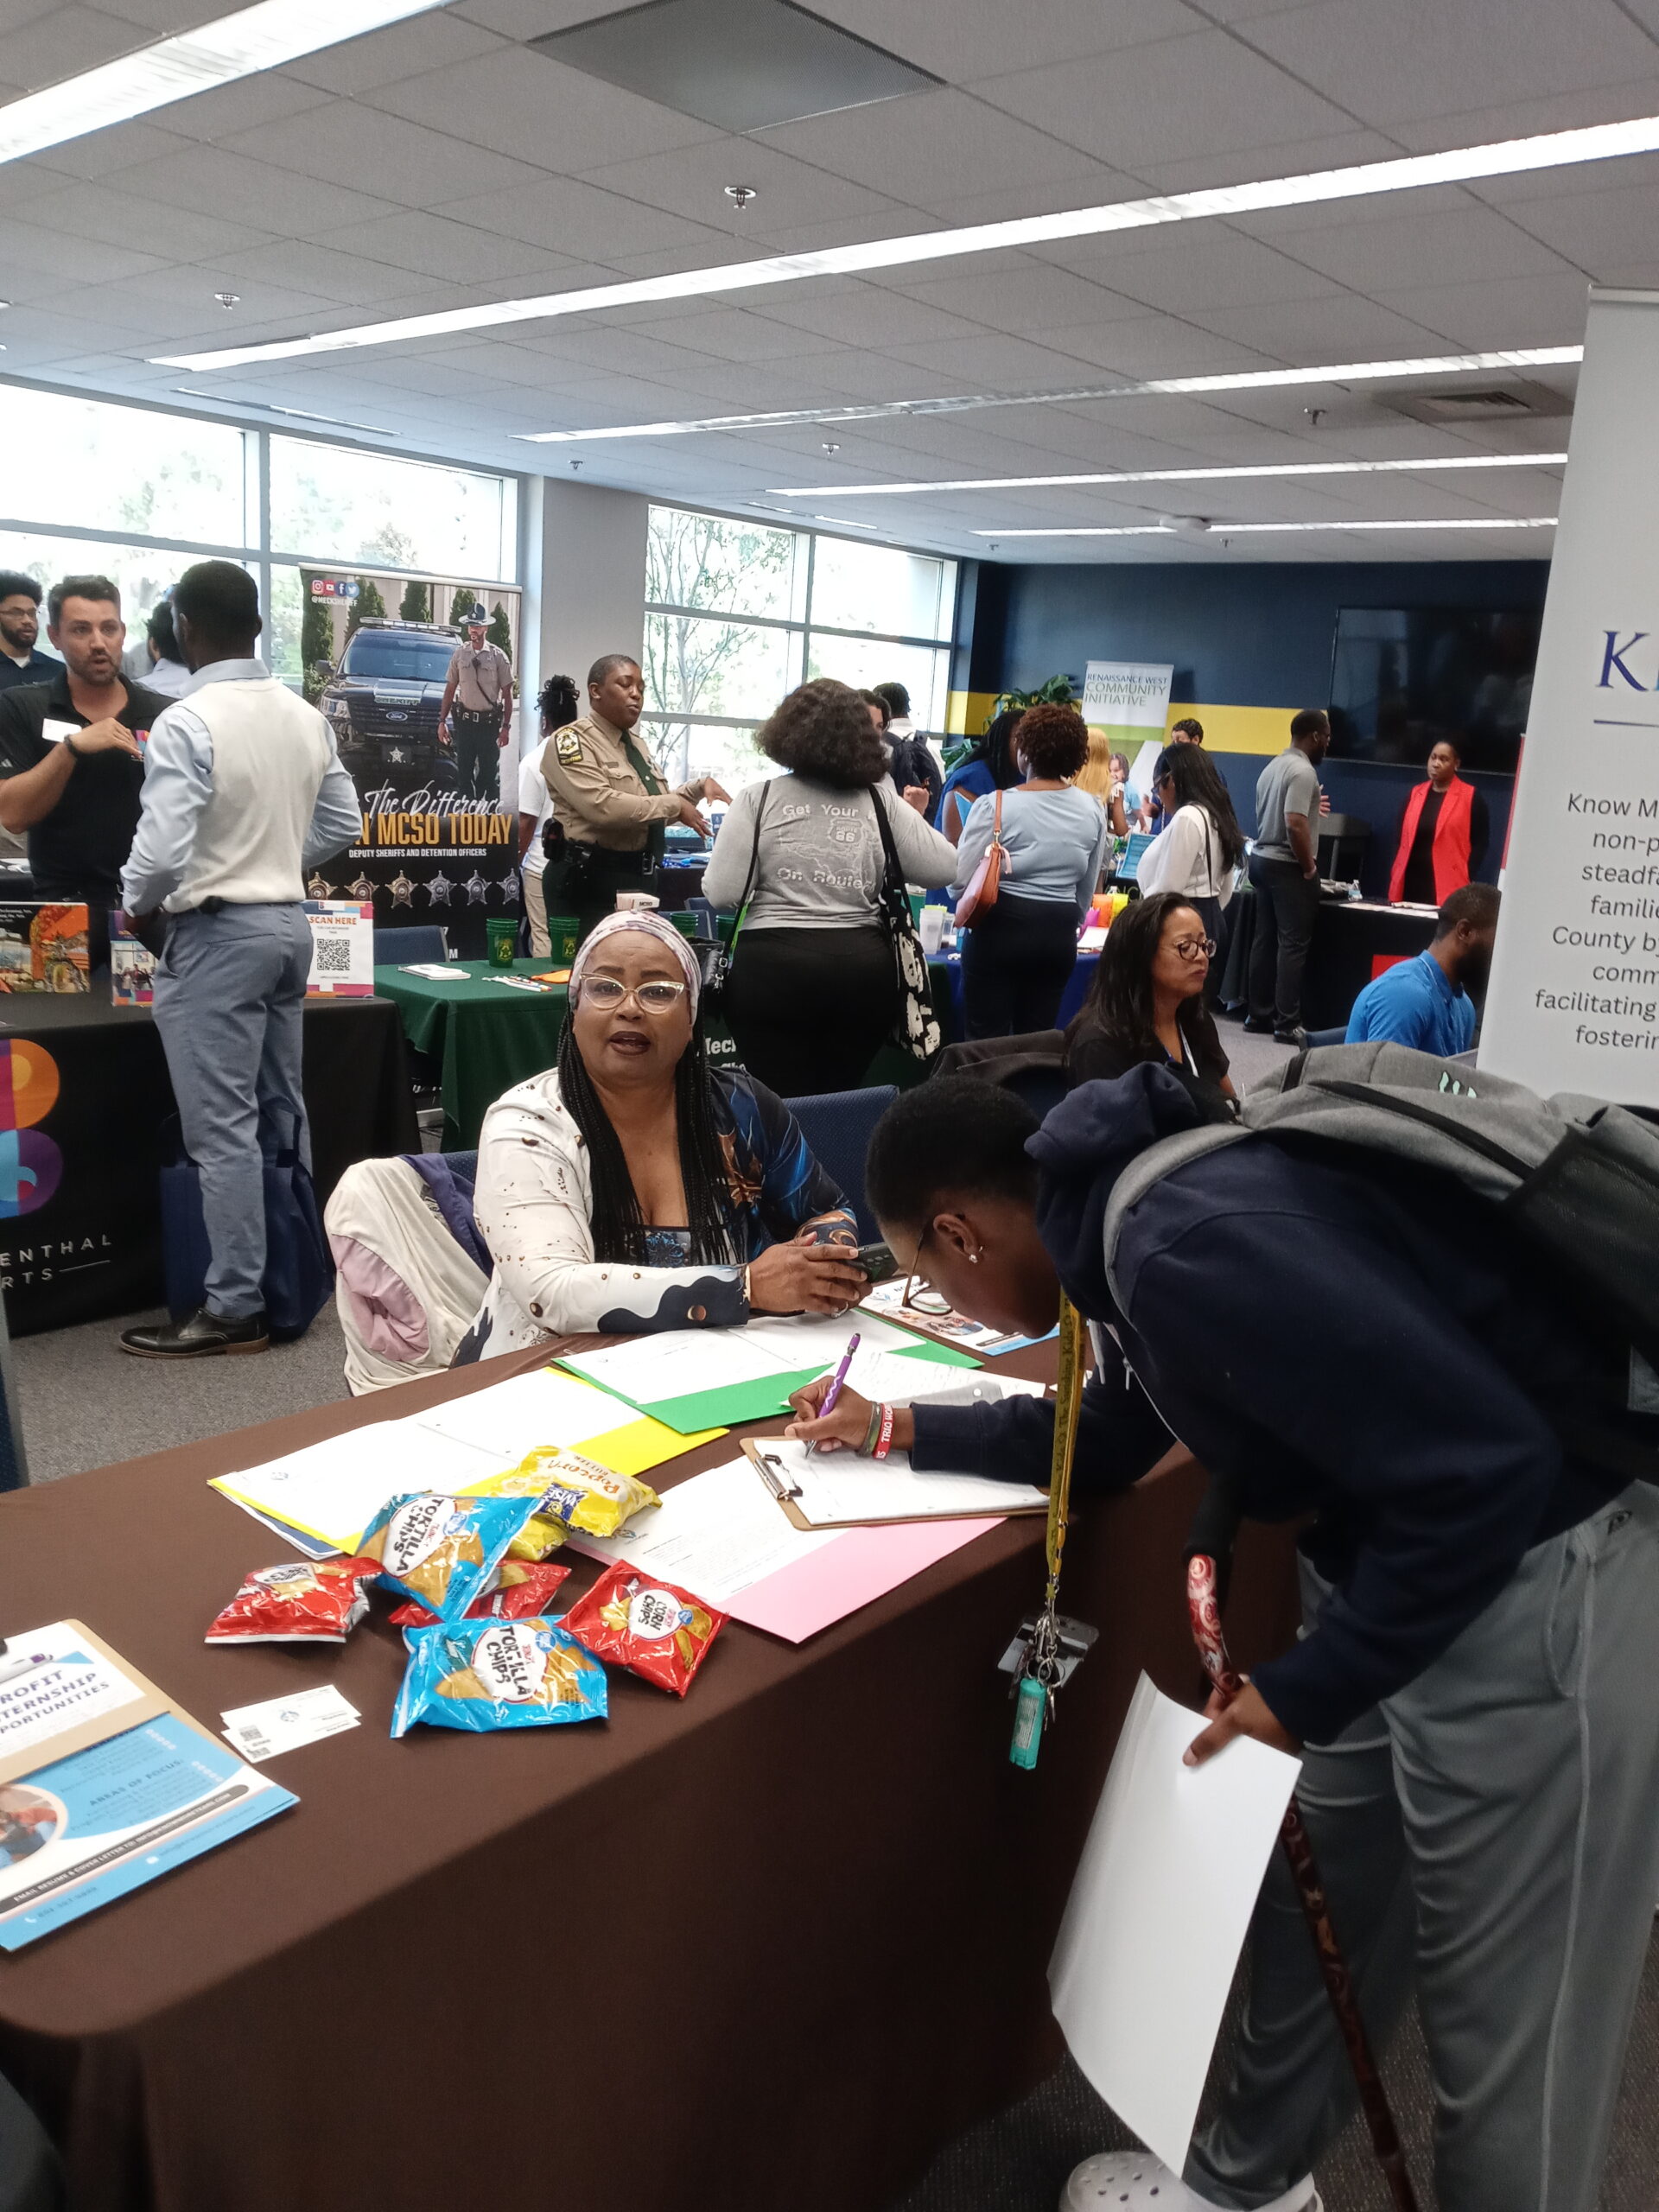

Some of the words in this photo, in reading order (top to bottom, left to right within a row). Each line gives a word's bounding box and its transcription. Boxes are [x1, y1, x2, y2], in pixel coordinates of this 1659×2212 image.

[1086, 682, 1167, 696] COMMUNITY
[1087, 673, 1141, 683] RENAISSANCE
[1084, 693, 1147, 706] INITIATIVE
[365, 779, 400, 828] The
[401, 780, 505, 818] Difference
[782, 804, 811, 816] Get
[821, 804, 859, 817] Your
[1567, 793, 1631, 817] Know
[378, 812, 440, 846] MCSO
[448, 812, 512, 845] TODAY
[836, 832, 855, 842] 66
[348, 849, 375, 858] DEPUTY
[375, 849, 405, 858] SHERIFFS
[406, 849, 419, 857] AND
[421, 848, 457, 857] DETENTION
[458, 848, 486, 857] OFFICERS
[309, 916, 333, 925] SCAN
[335, 917, 357, 925] HERE
[1553, 926, 1636, 955] County
[1535, 989, 1657, 1022] facilitating
[0, 1234, 111, 1267] ENTHAL
[881, 1421, 892, 1443] TRIO
[543, 1484, 578, 1508] WISE
[393, 1504, 421, 1553] CHIPS
[396, 1497, 445, 1573] TORTILLA
[638, 1594, 656, 1625] CHIPS
[650, 1600, 668, 1630] CORN
[486, 1641, 512, 1684] CHIPS
[499, 1625, 529, 1696] TORTILLA
